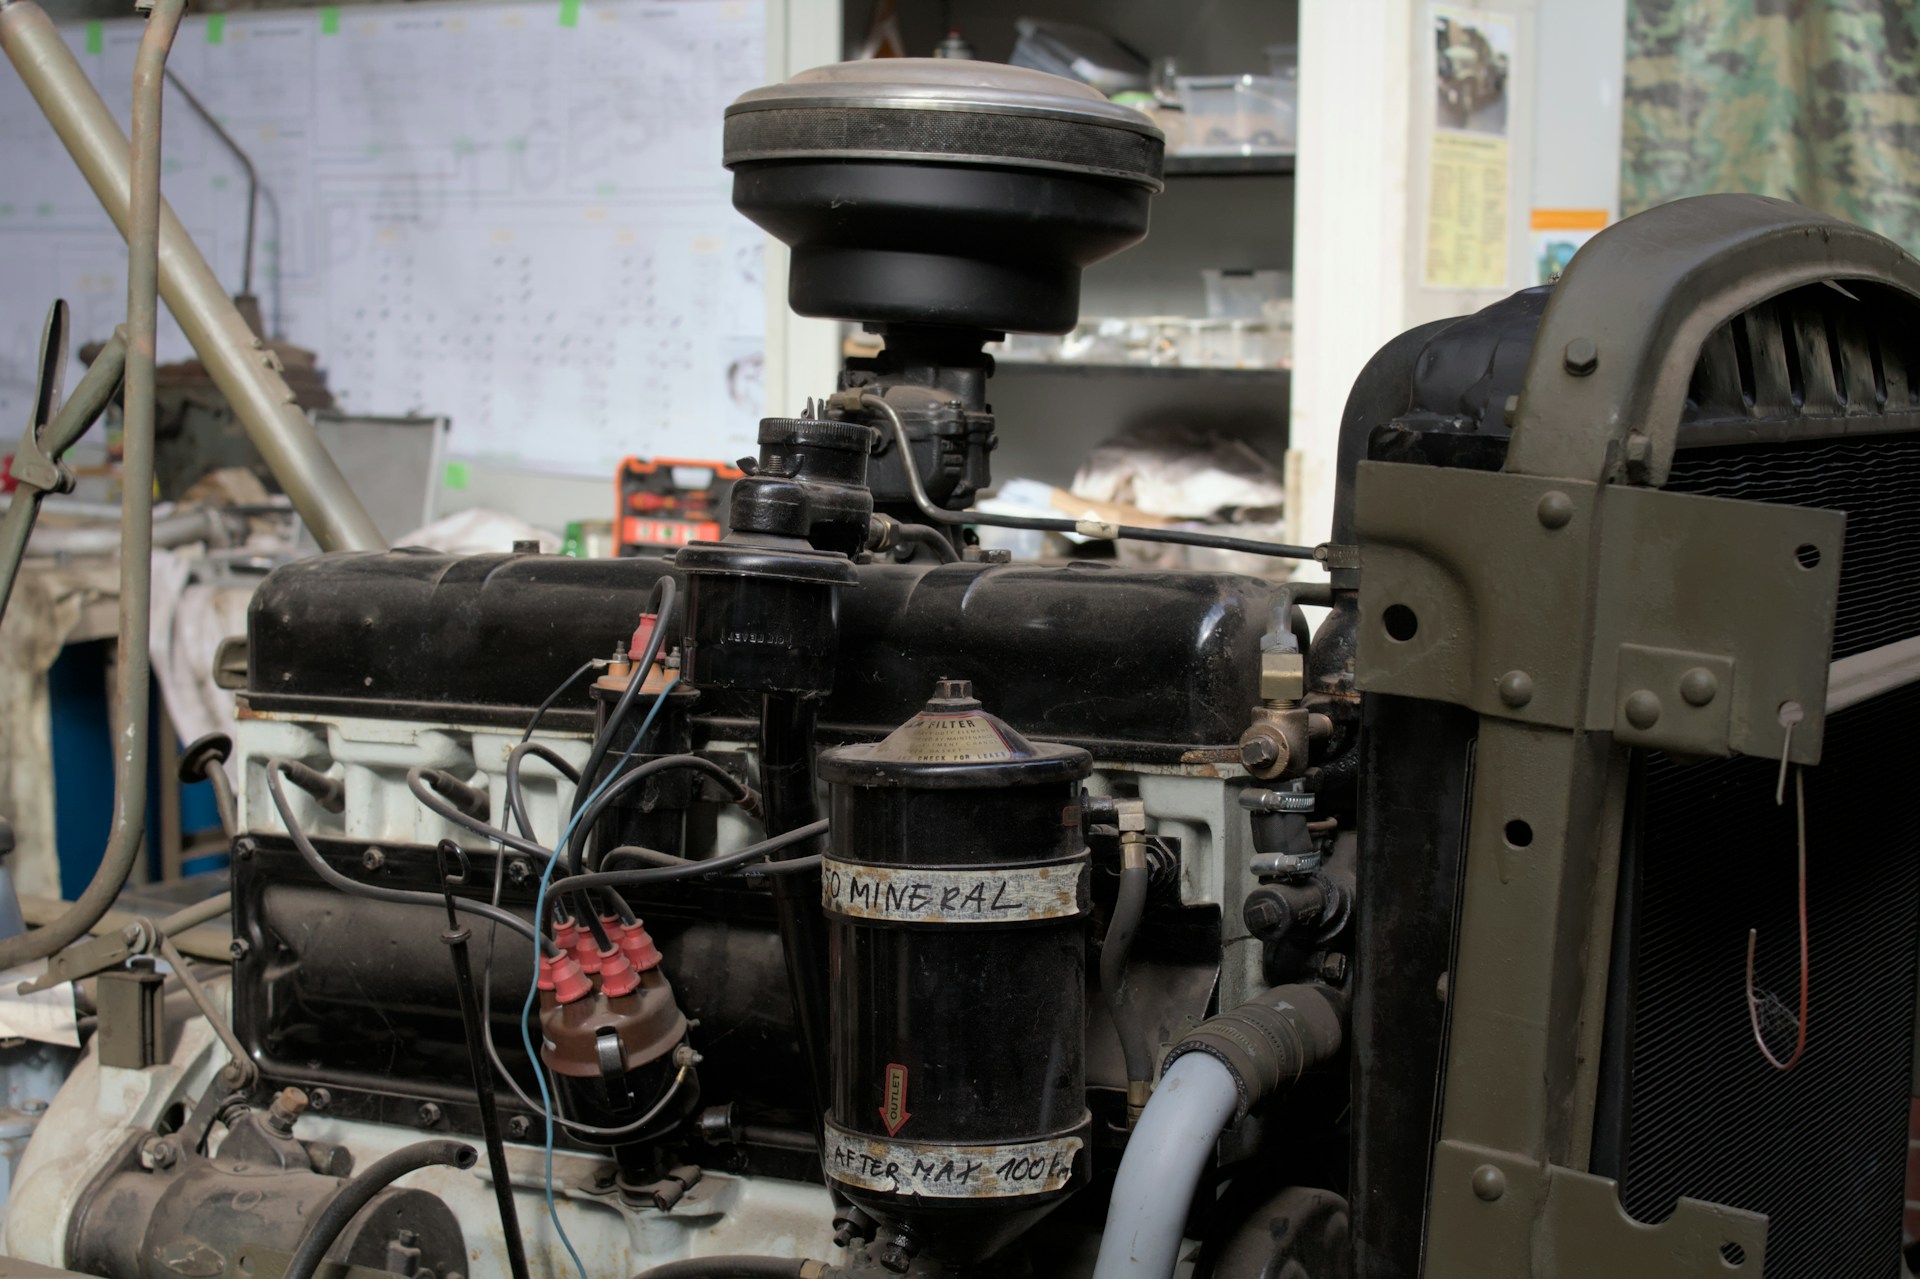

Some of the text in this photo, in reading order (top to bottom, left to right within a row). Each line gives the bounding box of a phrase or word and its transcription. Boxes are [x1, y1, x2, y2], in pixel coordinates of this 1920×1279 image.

[928, 719, 976, 729] FILTER
[850, 875, 1024, 912] MINERAL
[890, 1072, 900, 1120] OUTLET
[834, 1145, 901, 1183] AFTER
[911, 1158, 982, 1185] MAX
